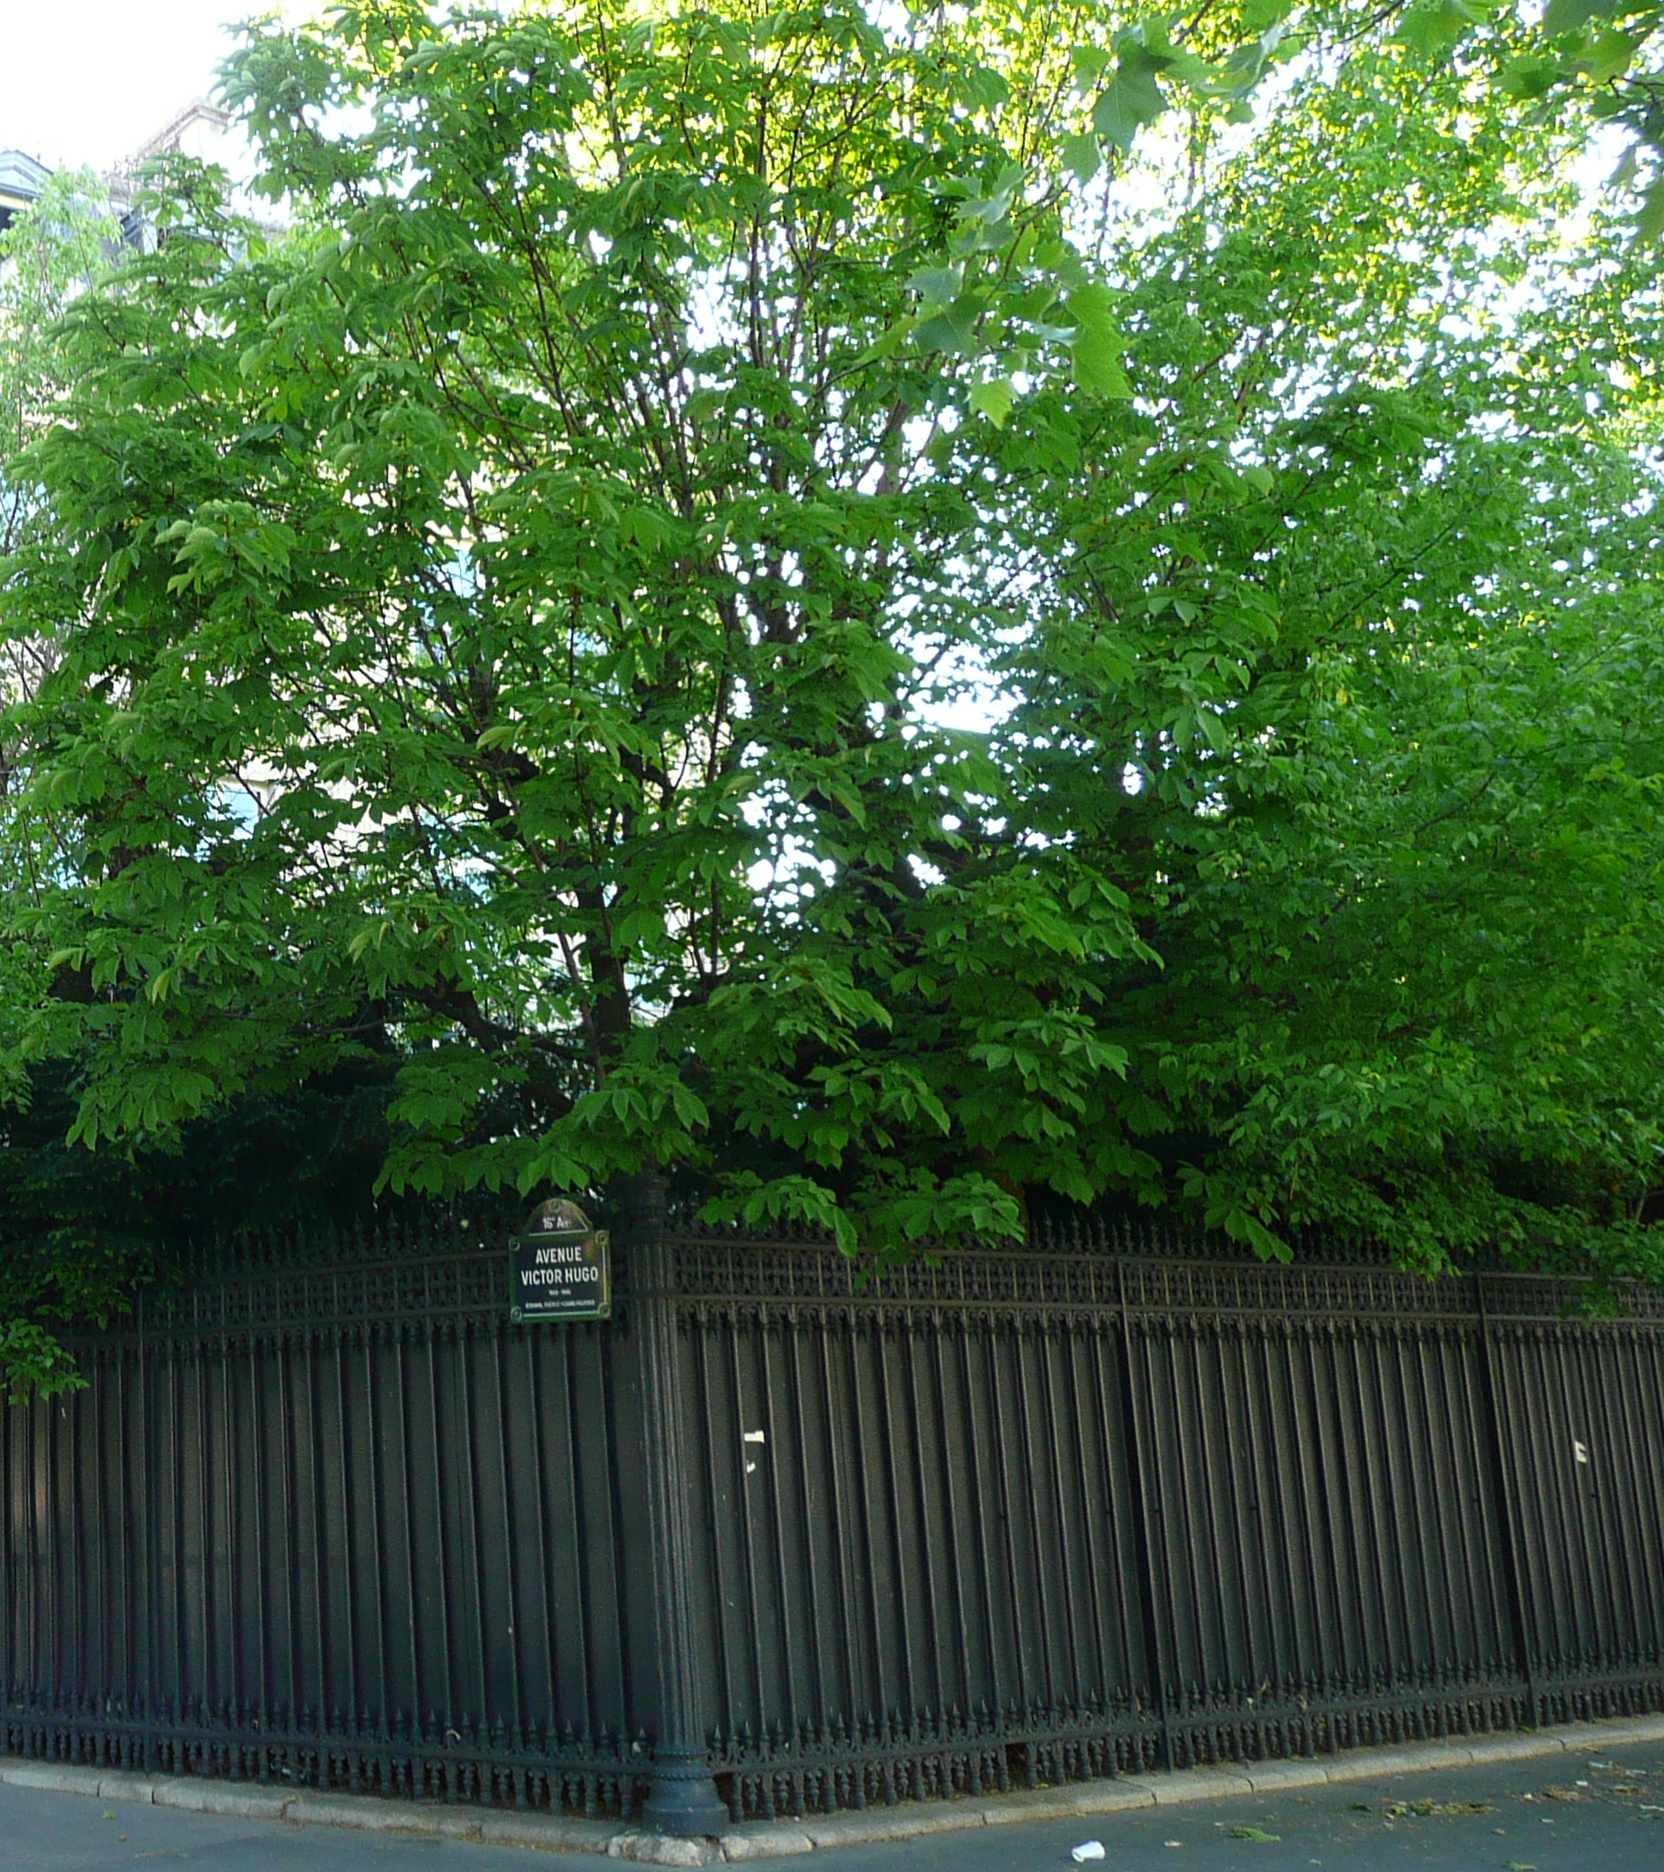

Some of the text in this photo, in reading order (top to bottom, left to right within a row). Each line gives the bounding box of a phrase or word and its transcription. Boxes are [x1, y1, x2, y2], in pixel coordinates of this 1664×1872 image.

[535, 1247, 582, 1264] AVENUE
[521, 1267, 599, 1286] VICTOR HUGO
